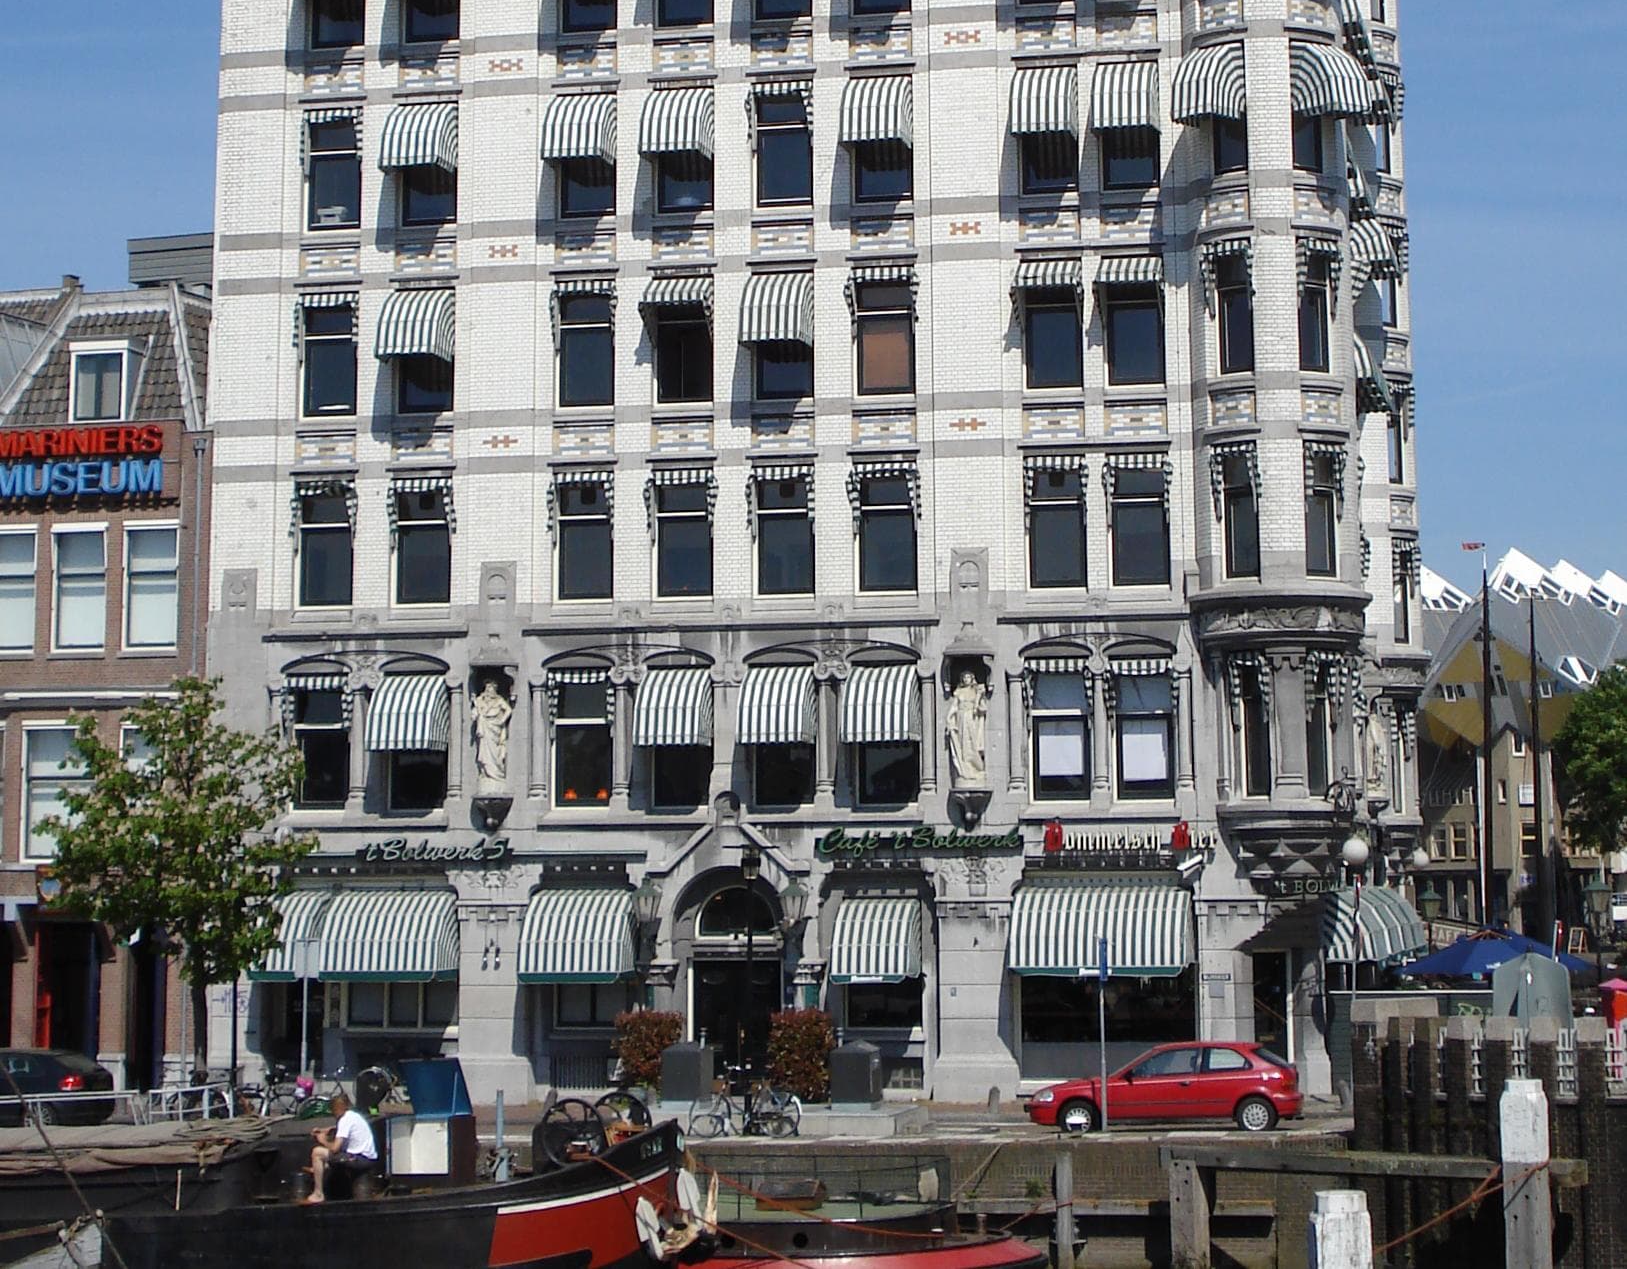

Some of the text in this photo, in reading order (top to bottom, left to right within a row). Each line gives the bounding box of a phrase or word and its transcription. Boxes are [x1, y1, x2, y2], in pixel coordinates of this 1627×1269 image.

[0, 424, 163, 458] MARINIERS
[0, 457, 163, 498] MUSEUM
[383, 837, 484, 861] Bolwerk
[819, 826, 881, 857] Café
[911, 826, 1020, 849] Bolwerk
[1043, 819, 1217, 852] Dommelsch Bier
